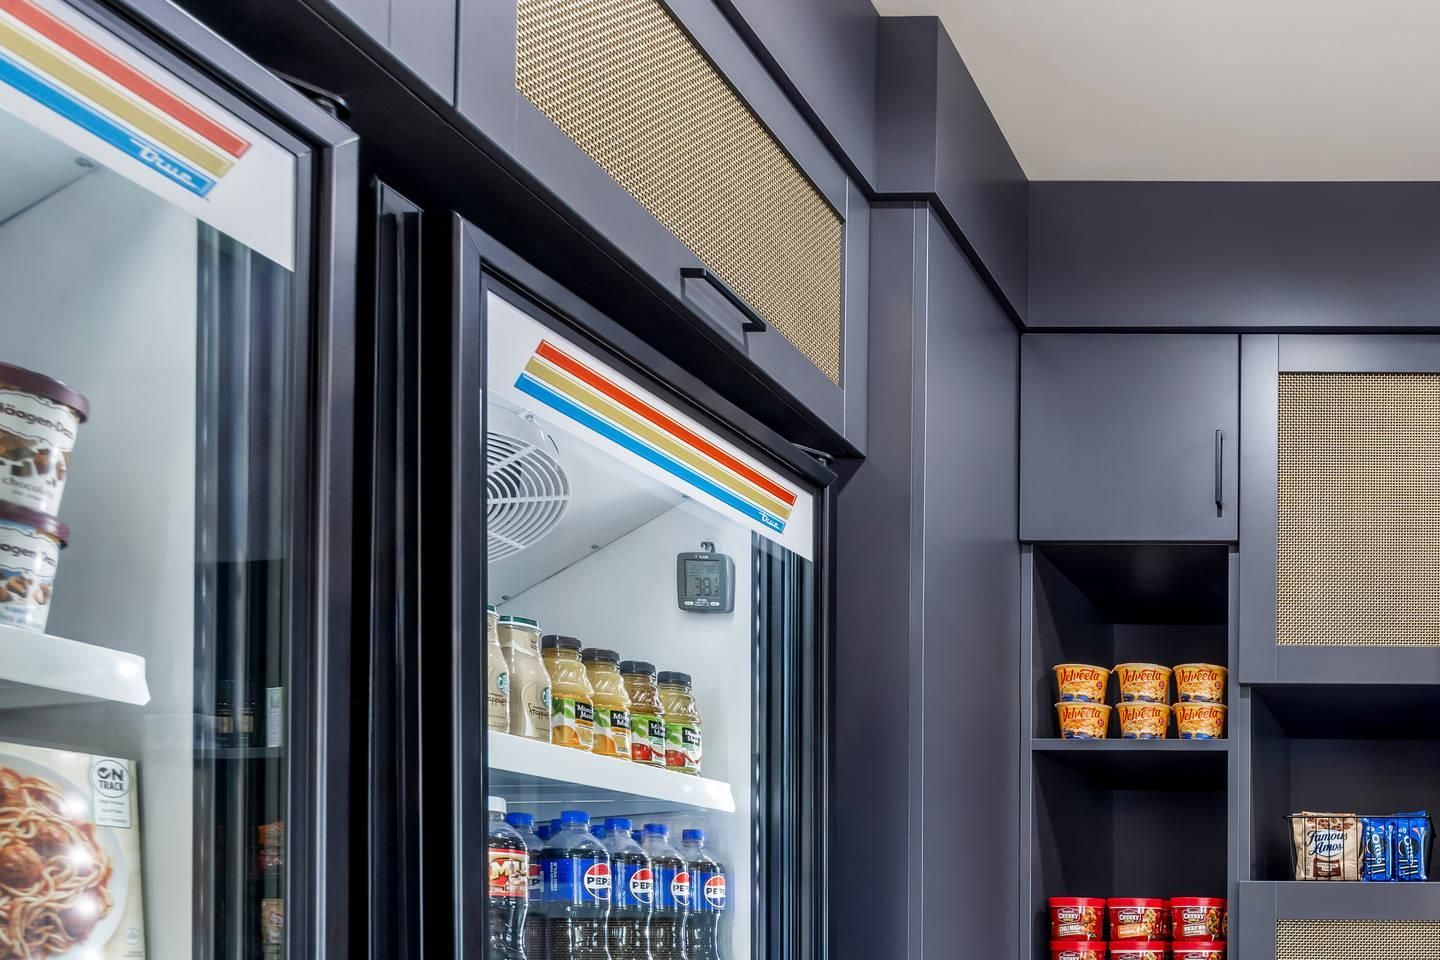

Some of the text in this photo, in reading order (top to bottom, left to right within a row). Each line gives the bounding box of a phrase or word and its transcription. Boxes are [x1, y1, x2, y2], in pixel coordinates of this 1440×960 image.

[1061, 669, 1100, 685] Velveeta
[1122, 669, 1161, 685] Velveeta
[1179, 669, 1217, 685] Velveeta
[1063, 706, 1100, 722] Velveeta
[1122, 706, 1161, 722] Velveeta
[1179, 706, 1218, 722] Velveeta
[98, 780, 125, 792] TRACK
[1306, 830, 1348, 847] Famous
[672, 884, 688, 893] PE
